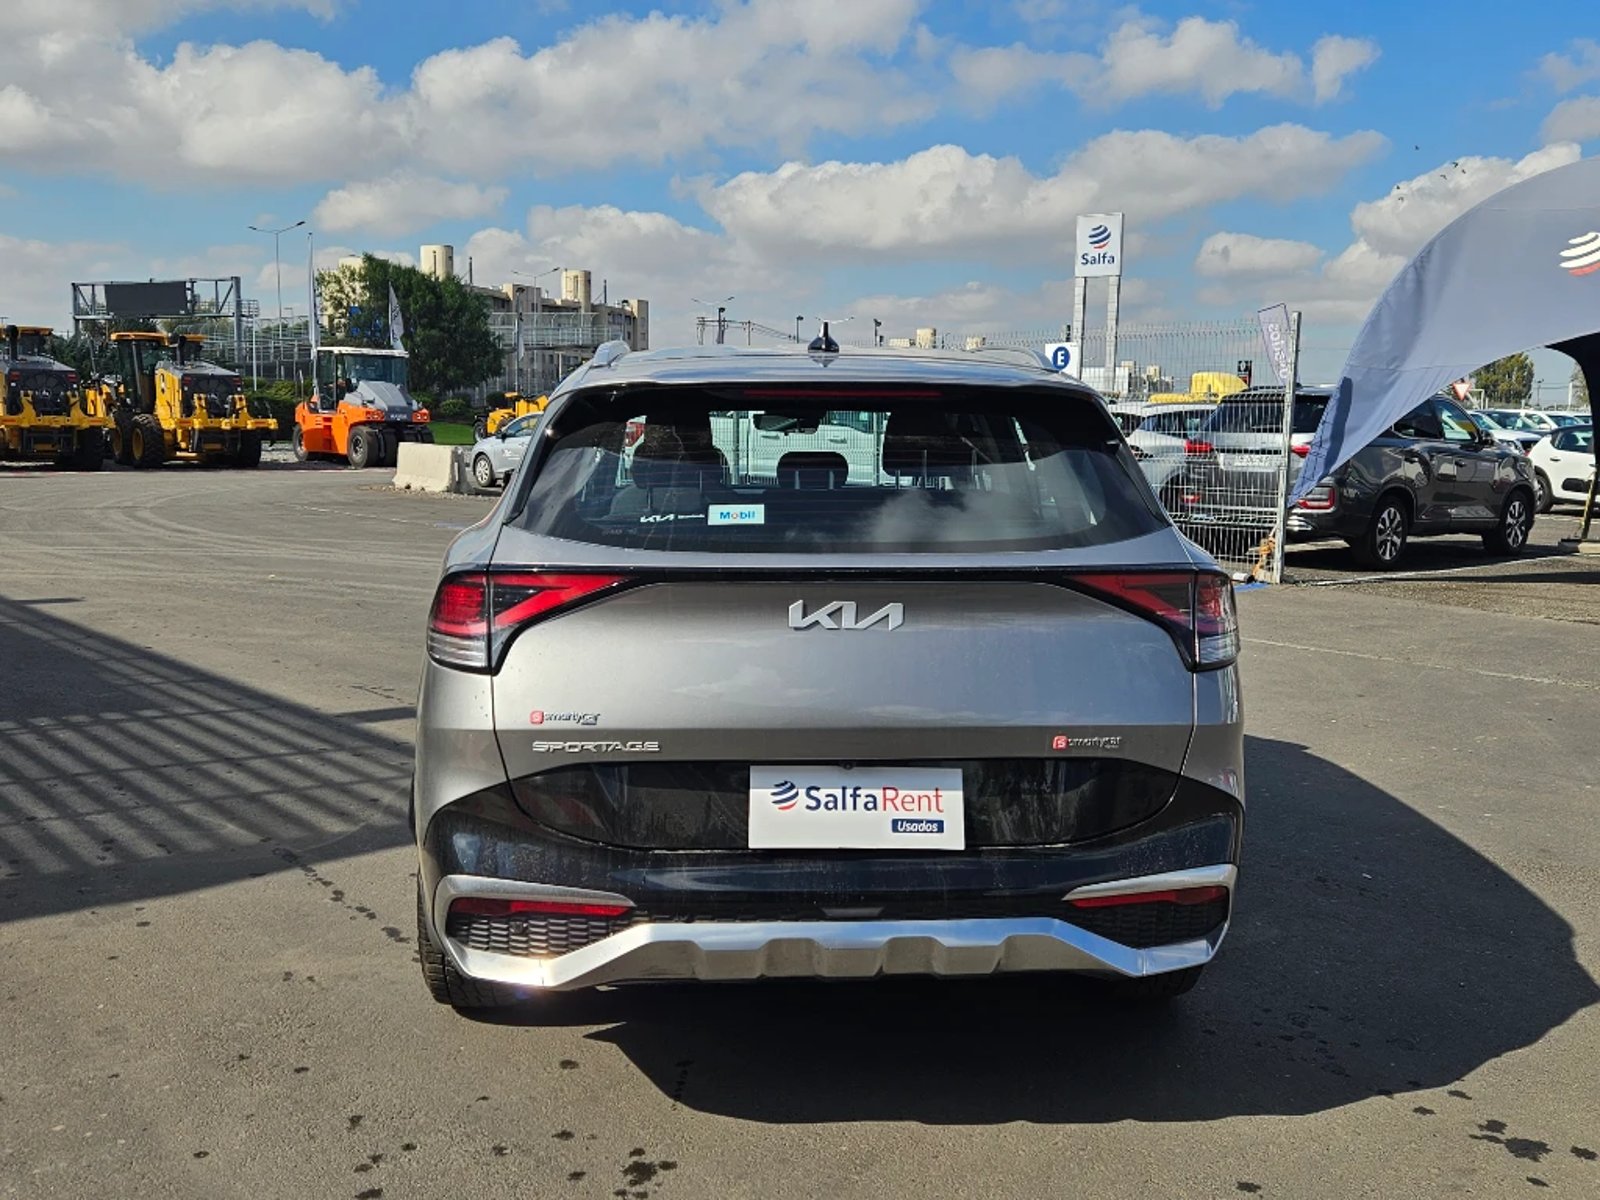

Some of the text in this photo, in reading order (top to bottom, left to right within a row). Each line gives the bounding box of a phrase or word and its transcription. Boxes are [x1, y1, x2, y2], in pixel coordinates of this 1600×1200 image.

[1080, 252, 1115, 266] Salfa
[719, 510, 756, 520] Mobil
[788, 599, 904, 631] KIA
[532, 741, 660, 753] SPORTAGE
[897, 820, 938, 832] Usados
